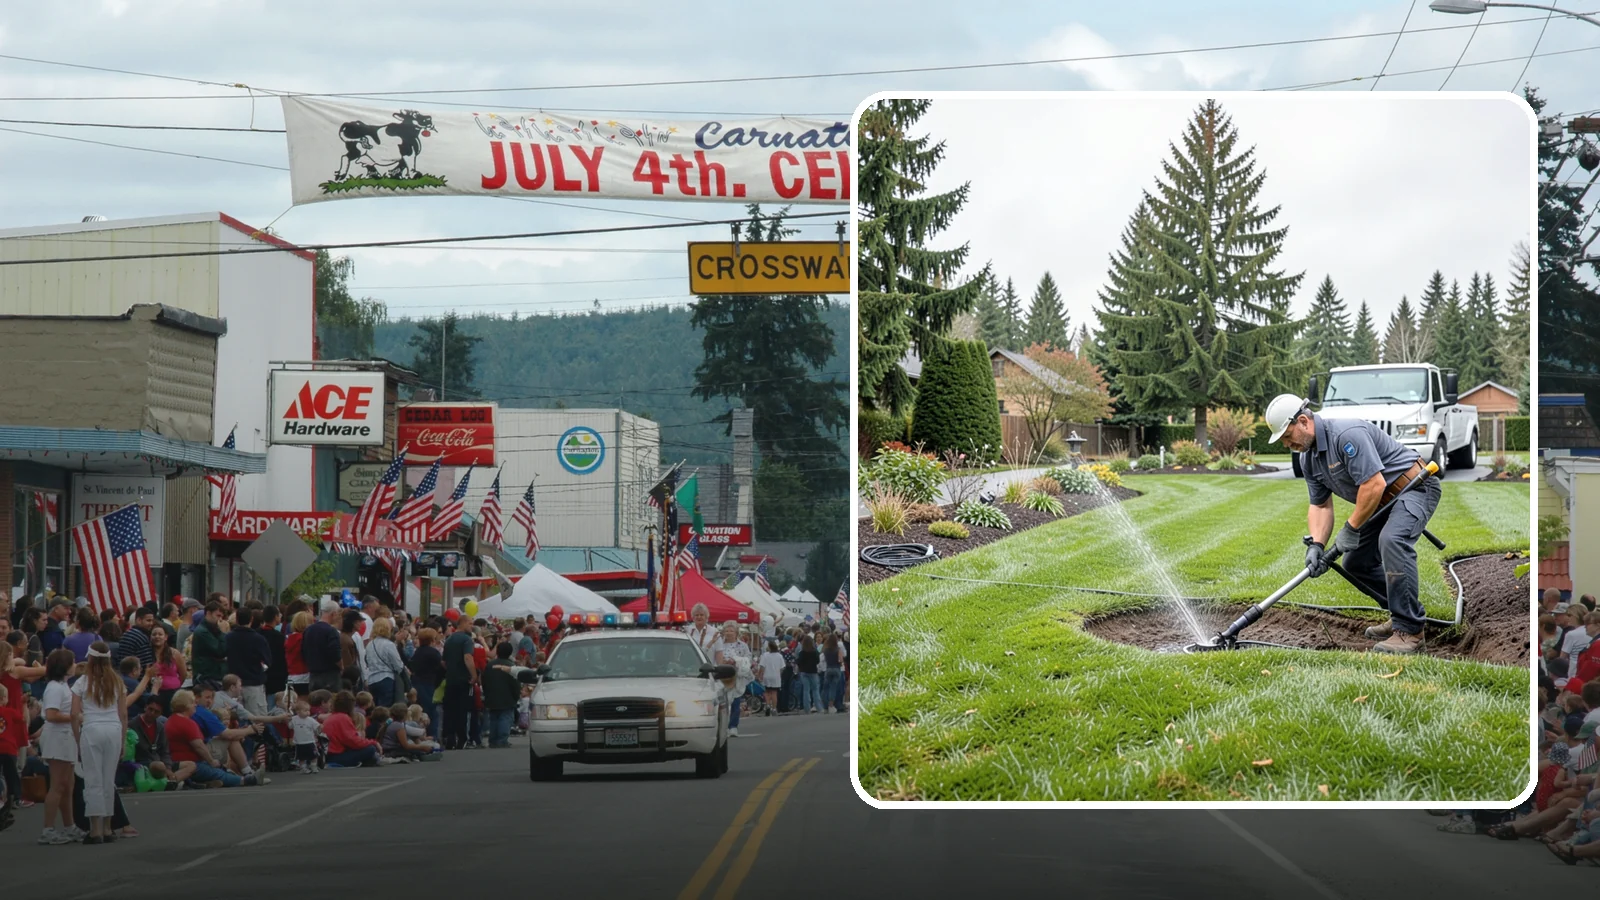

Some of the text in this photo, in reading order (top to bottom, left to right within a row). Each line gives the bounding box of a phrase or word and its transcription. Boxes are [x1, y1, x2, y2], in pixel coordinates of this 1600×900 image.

[695, 121, 850, 150] Carnat
[481, 141, 604, 192] JULY
[632, 150, 746, 197] 4th.
[697, 254, 850, 280] CROSSWA
[282, 380, 373, 420] ACE
[405, 409, 452, 422] CEDAR
[283, 421, 370, 436] Hardware
[416, 428, 477, 447] Coca-Cola
[353, 467, 386, 480] Simpl
[95, 485, 124, 494] Vincent
[126, 486, 136, 494] de
[137, 486, 155, 495] Paul
[212, 516, 330, 535] HARDARE
[688, 526, 741, 535] CRNATION
[699, 535, 730, 543] GLASS
